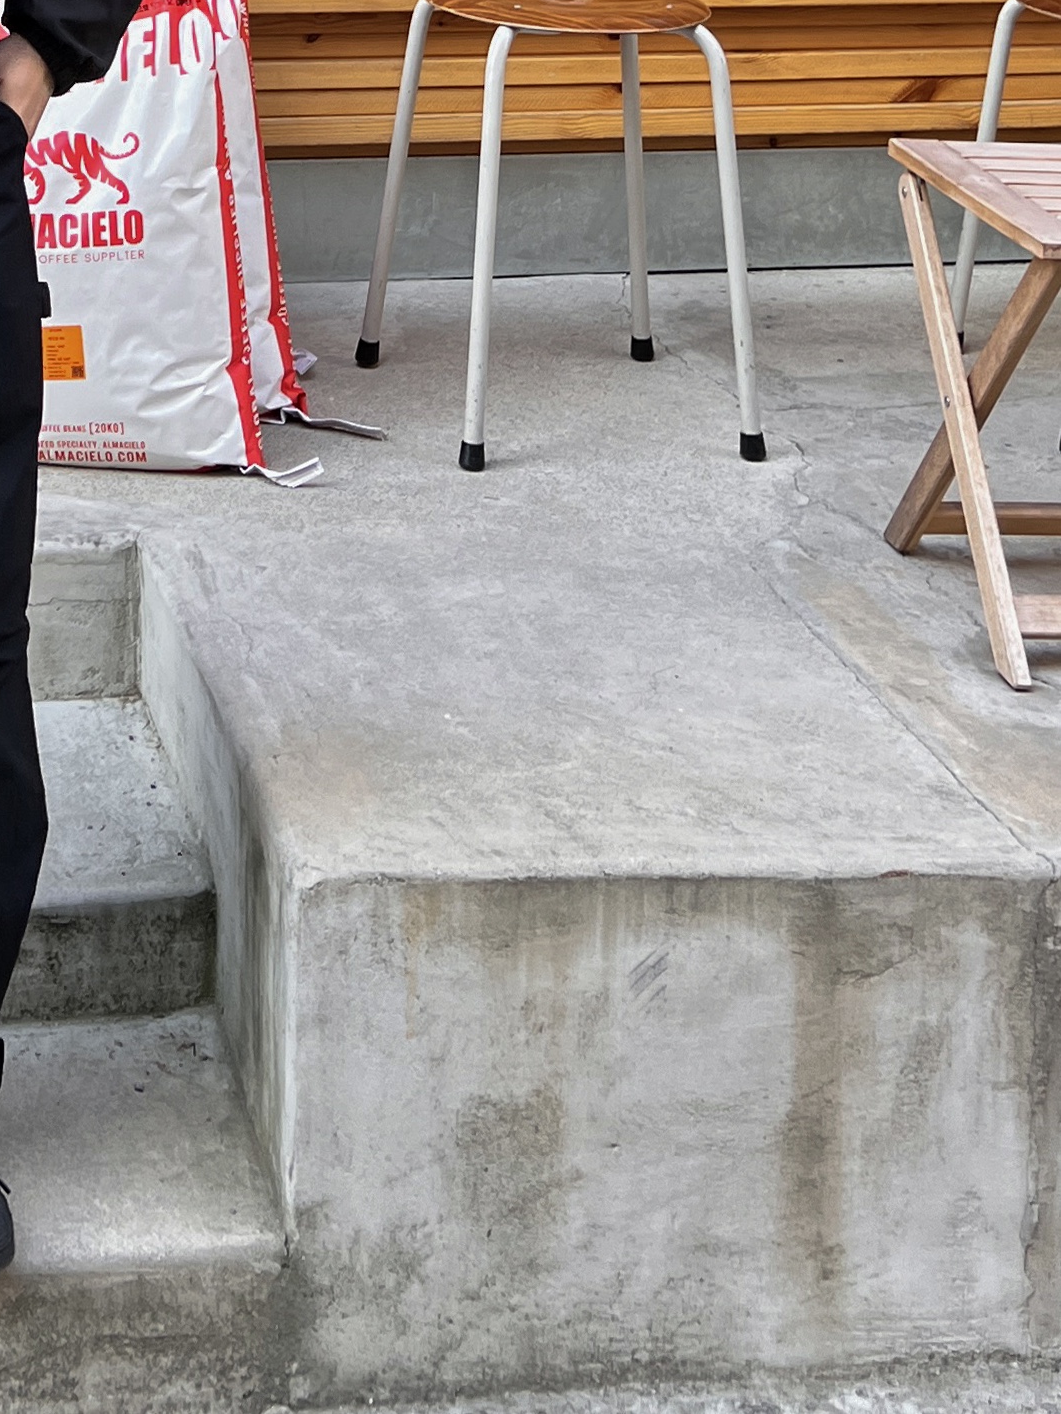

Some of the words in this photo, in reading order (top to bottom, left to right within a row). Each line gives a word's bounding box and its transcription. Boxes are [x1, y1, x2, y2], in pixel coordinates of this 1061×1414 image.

[31, 209, 144, 249] ACIELO
[38, 253, 78, 264] OFFEE
[84, 250, 145, 263] SUPPLIER
